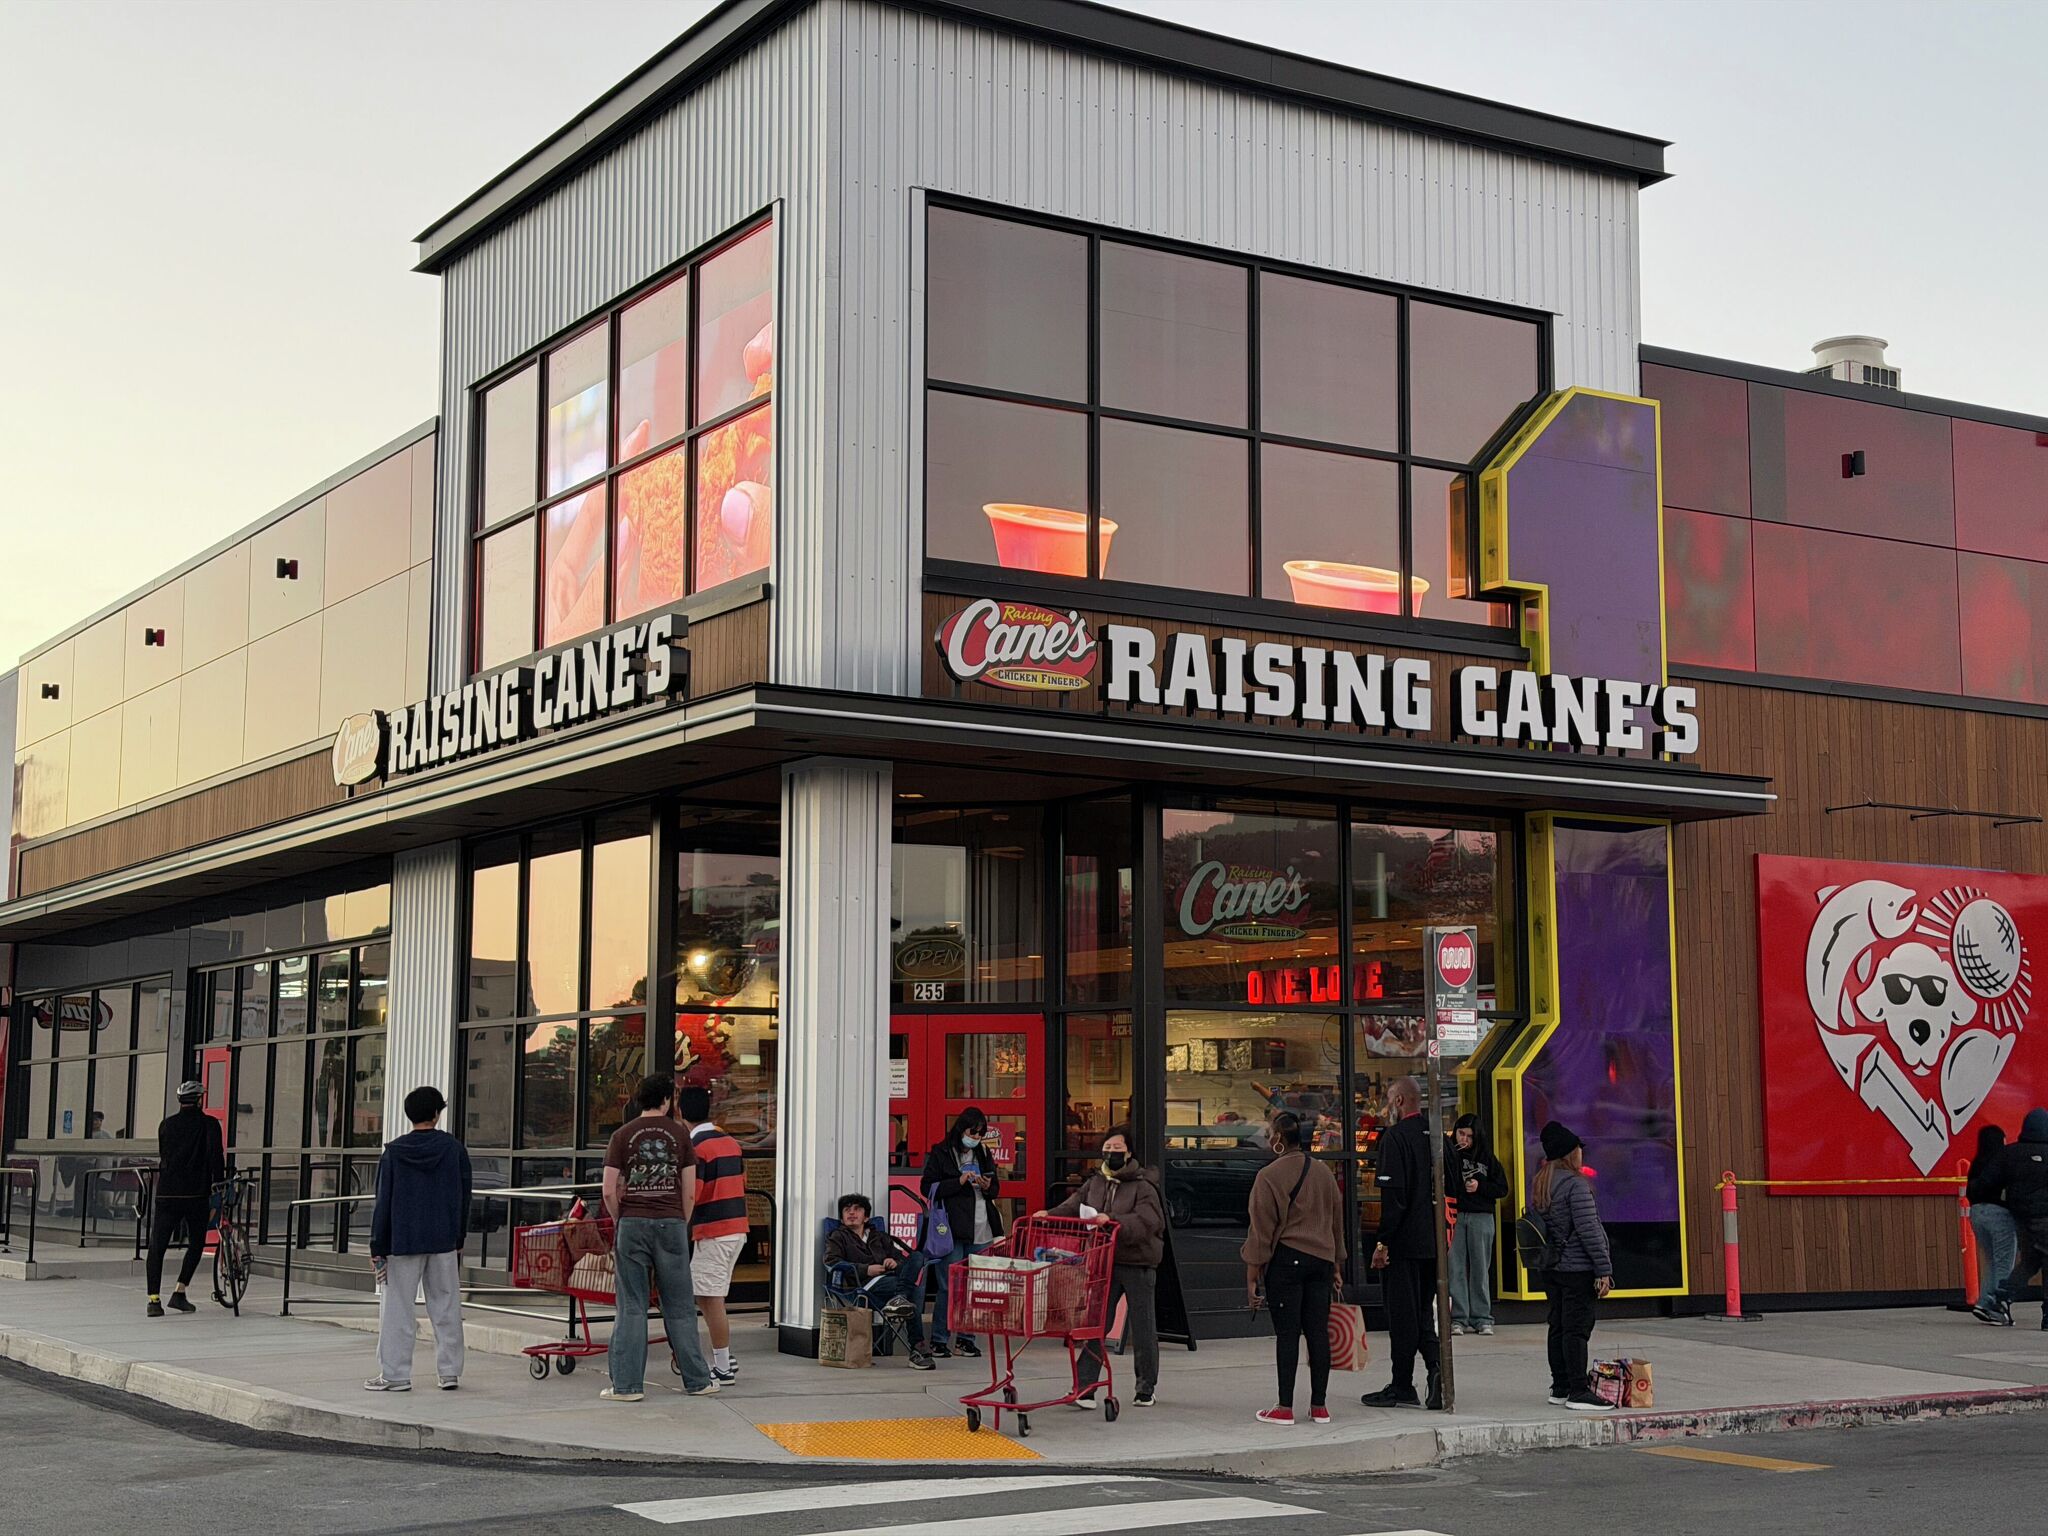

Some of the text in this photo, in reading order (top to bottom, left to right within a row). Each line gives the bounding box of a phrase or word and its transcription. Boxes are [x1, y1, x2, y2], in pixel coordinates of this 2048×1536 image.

[1002, 604, 1055, 627] Raising
[948, 598, 1097, 677] Cane's
[998, 668, 1039, 684] CHICKEN
[388, 613, 673, 774] RAISING CANE'S
[1107, 624, 1699, 754] RAISING CANE'S
[1229, 865, 1273, 881] Raising
[1180, 860, 1310, 936] Cane's
[903, 949, 959, 967] OPEN
[915, 983, 943, 1000] 255
[1247, 969, 1307, 1005] ONE
[1436, 994, 1446, 1008] 57
